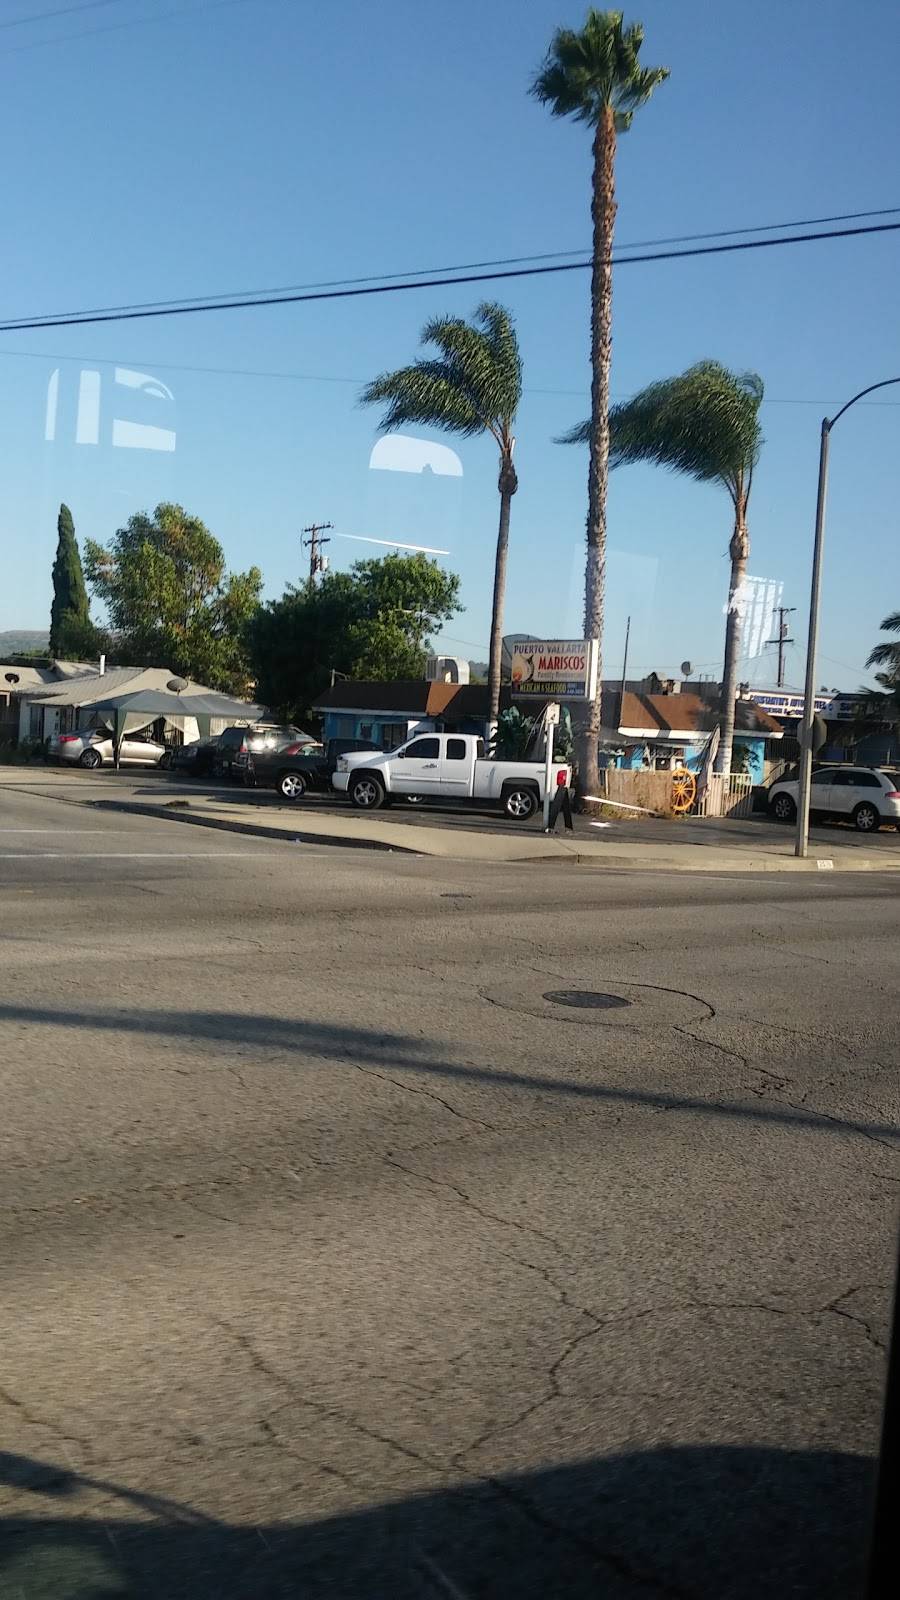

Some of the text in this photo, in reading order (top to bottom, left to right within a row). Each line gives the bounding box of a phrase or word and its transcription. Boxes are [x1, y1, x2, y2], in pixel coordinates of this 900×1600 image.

[514, 644, 586, 654] PUERTO VALLARTA
[538, 656, 585, 670] MARISCOS
[545, 683, 567, 694] SEAFOOD
